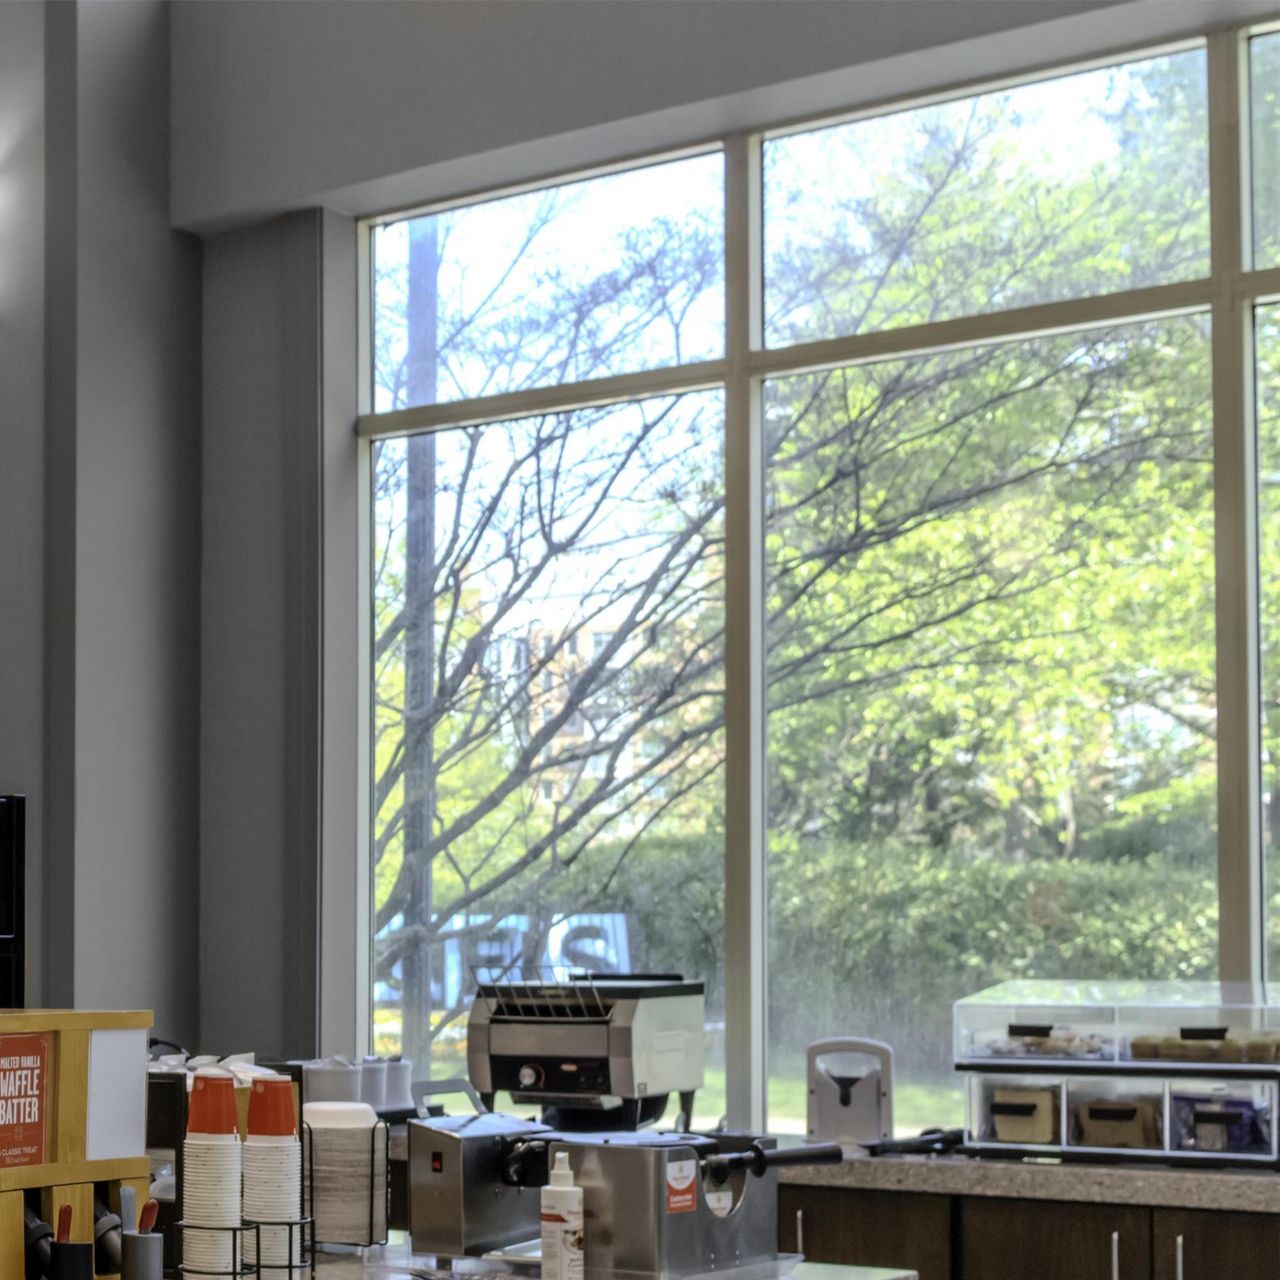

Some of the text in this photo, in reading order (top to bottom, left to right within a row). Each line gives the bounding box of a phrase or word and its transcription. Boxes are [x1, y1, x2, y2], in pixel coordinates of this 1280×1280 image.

[0, 1055, 40, 1069] MALTED VANILLA
[0, 1069, 40, 1097] WAFFLE
